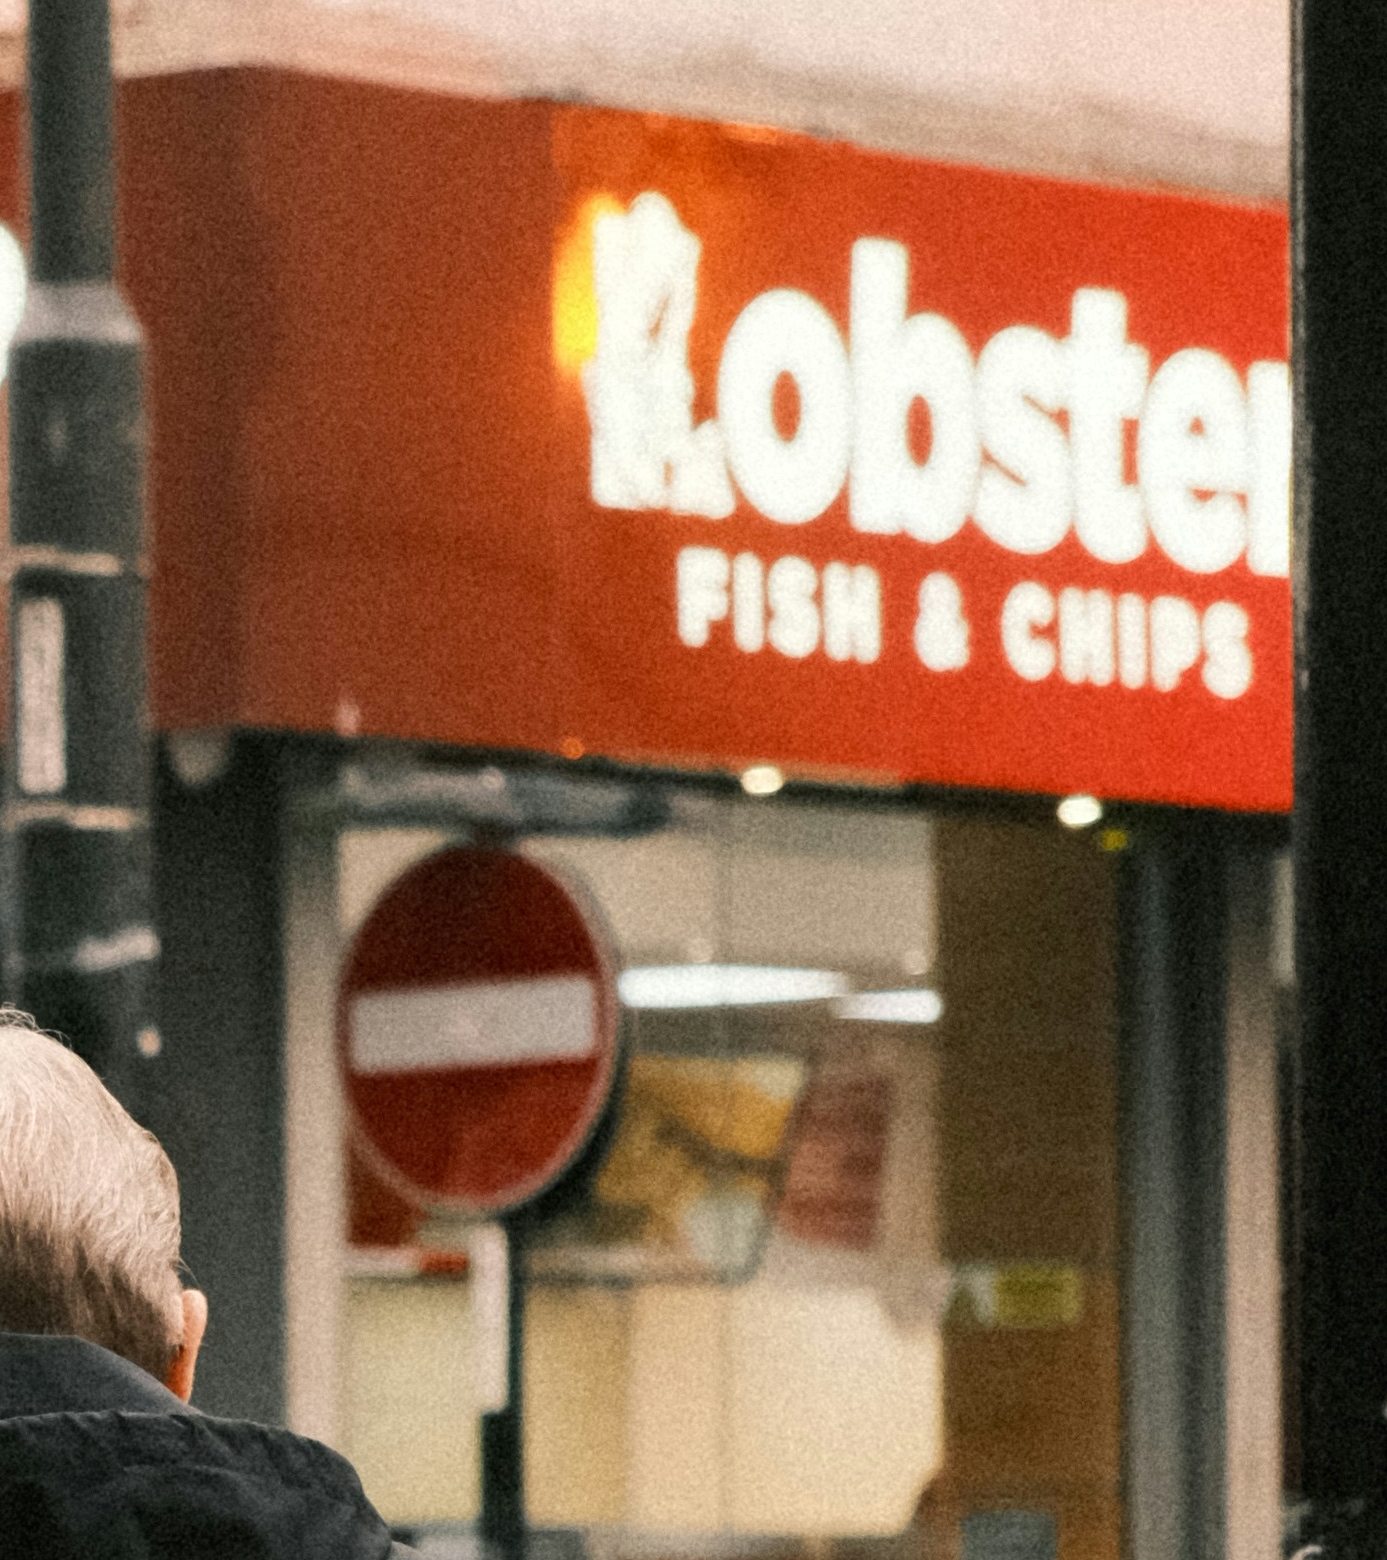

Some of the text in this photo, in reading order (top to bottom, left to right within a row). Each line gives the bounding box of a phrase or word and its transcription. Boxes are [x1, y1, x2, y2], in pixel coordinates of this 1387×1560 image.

[675, 544, 1254, 700] FISH & CHIPS
